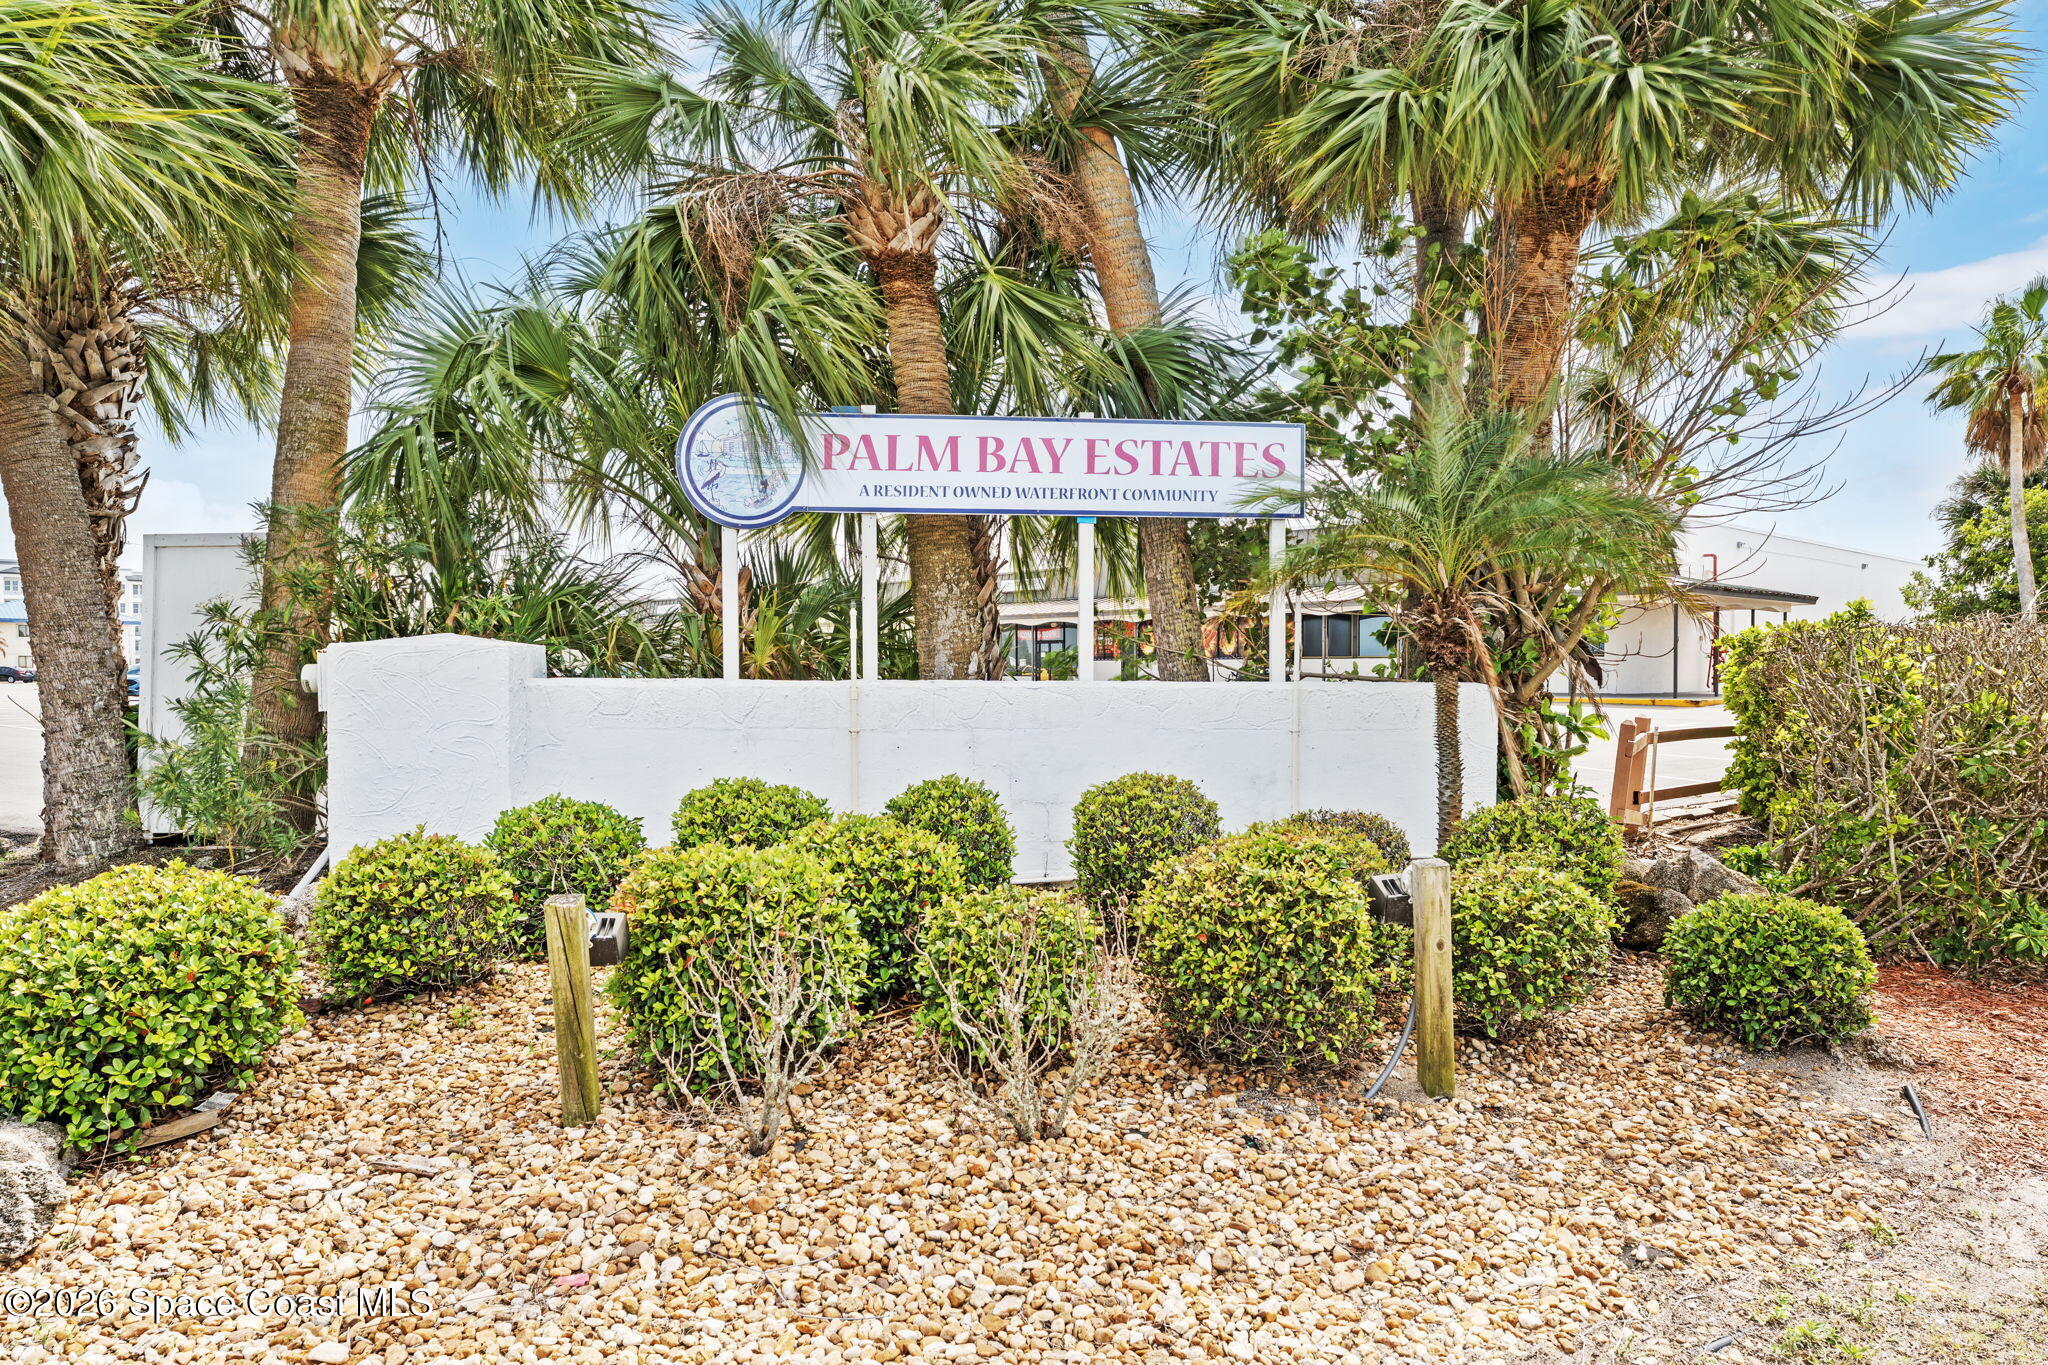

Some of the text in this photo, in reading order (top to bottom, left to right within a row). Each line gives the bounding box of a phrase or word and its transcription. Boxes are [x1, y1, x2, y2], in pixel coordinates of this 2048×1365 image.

[820, 432, 1287, 480] PALM BAY ESTATES
[858, 483, 1219, 503] A RESIDENT OWNED WATERFRONT COMMUNITY
